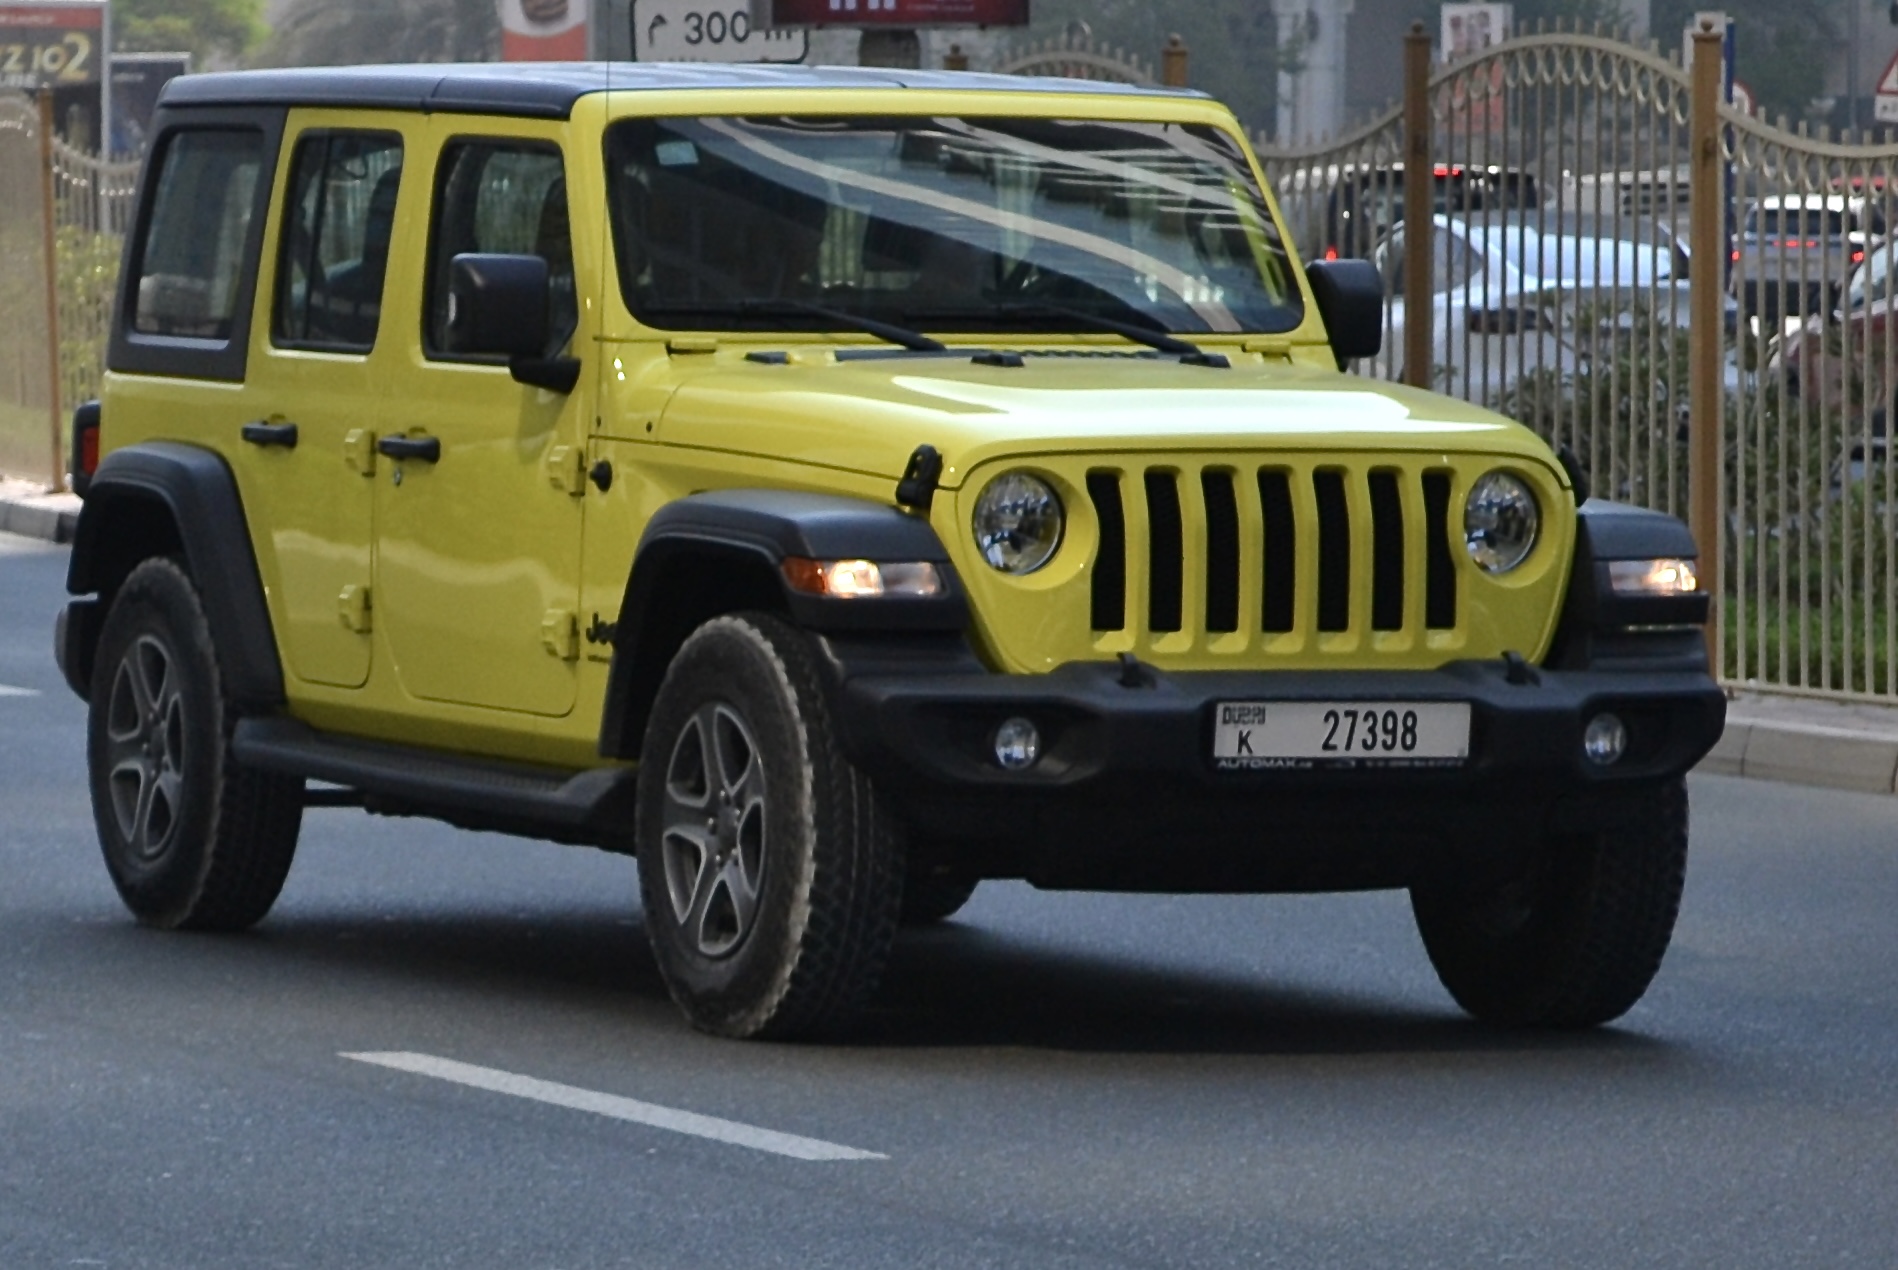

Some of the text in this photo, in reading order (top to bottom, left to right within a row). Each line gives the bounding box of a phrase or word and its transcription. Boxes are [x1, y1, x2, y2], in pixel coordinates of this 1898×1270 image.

[683, 11, 751, 45] 300
[1237, 709, 1418, 754] K 27398
